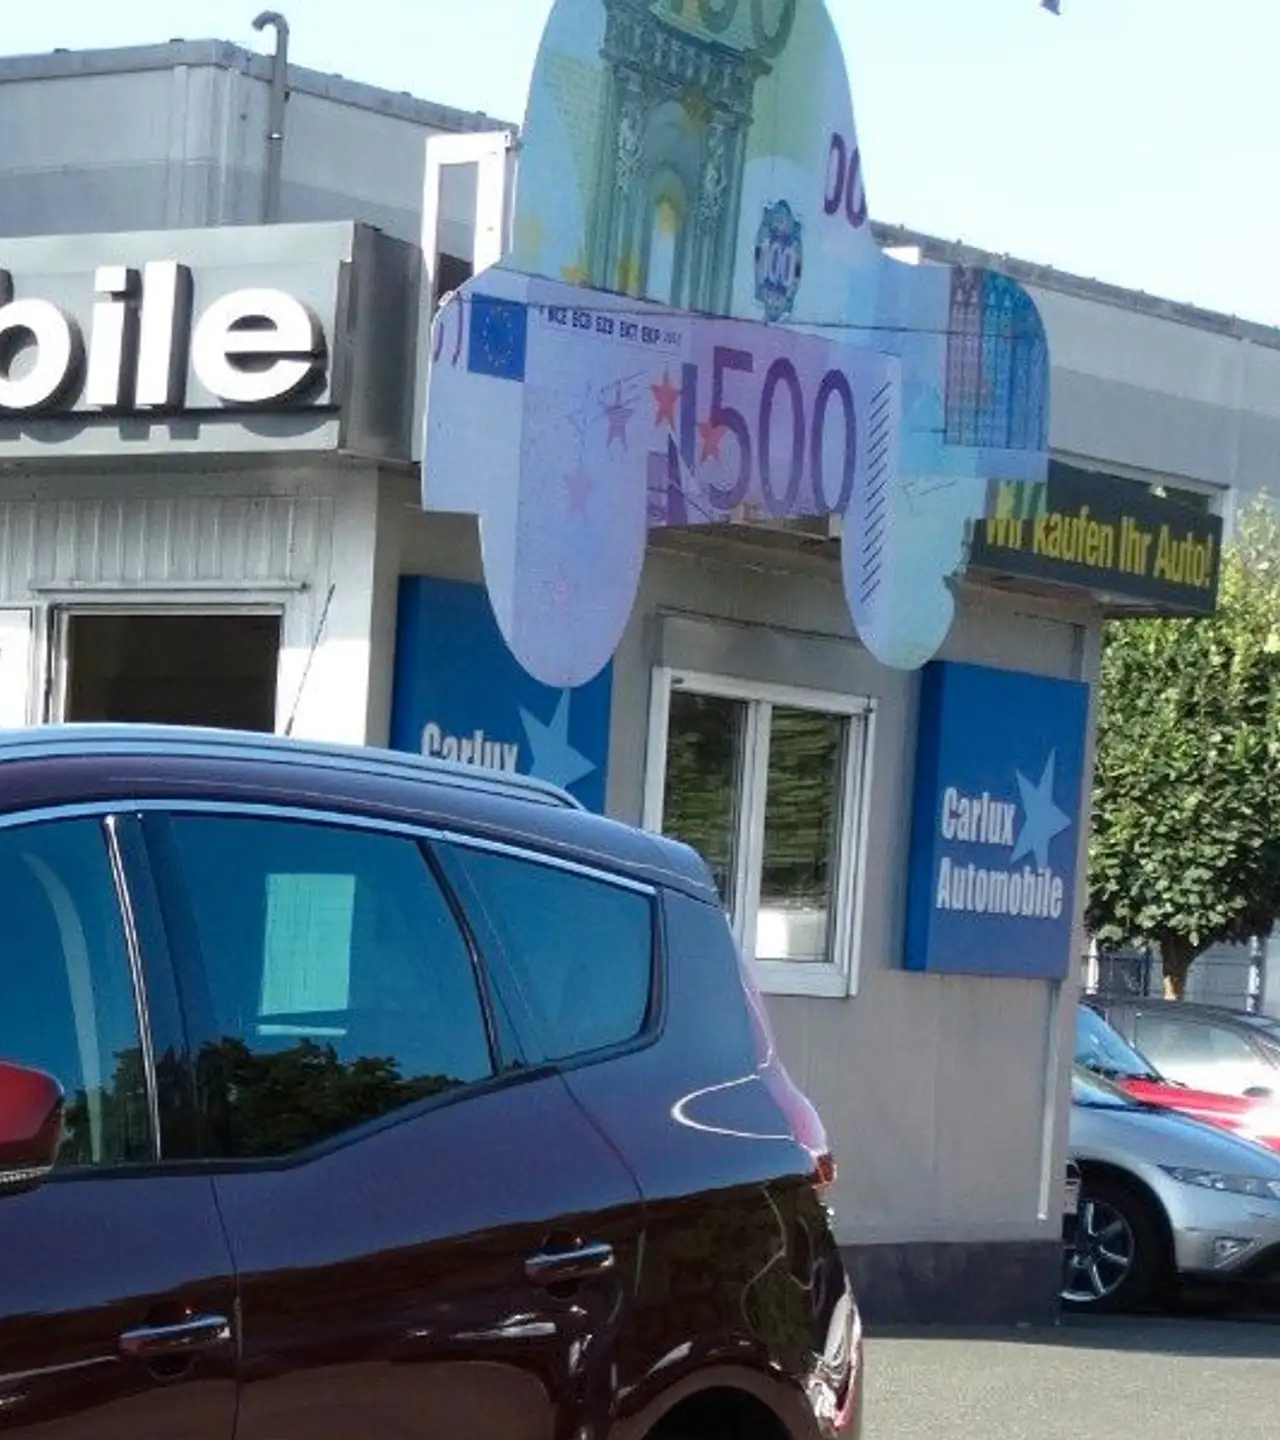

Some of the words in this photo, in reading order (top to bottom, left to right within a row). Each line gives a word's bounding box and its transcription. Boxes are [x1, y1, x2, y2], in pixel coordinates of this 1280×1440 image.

[709, 345, 857, 518] 500
[1032, 504, 1114, 570] kaufen
[1119, 515, 1151, 576] Ihr
[1153, 524, 1213, 589] Auto!
[941, 786, 1016, 846] Carlux
[936, 857, 1064, 919] Automobile
